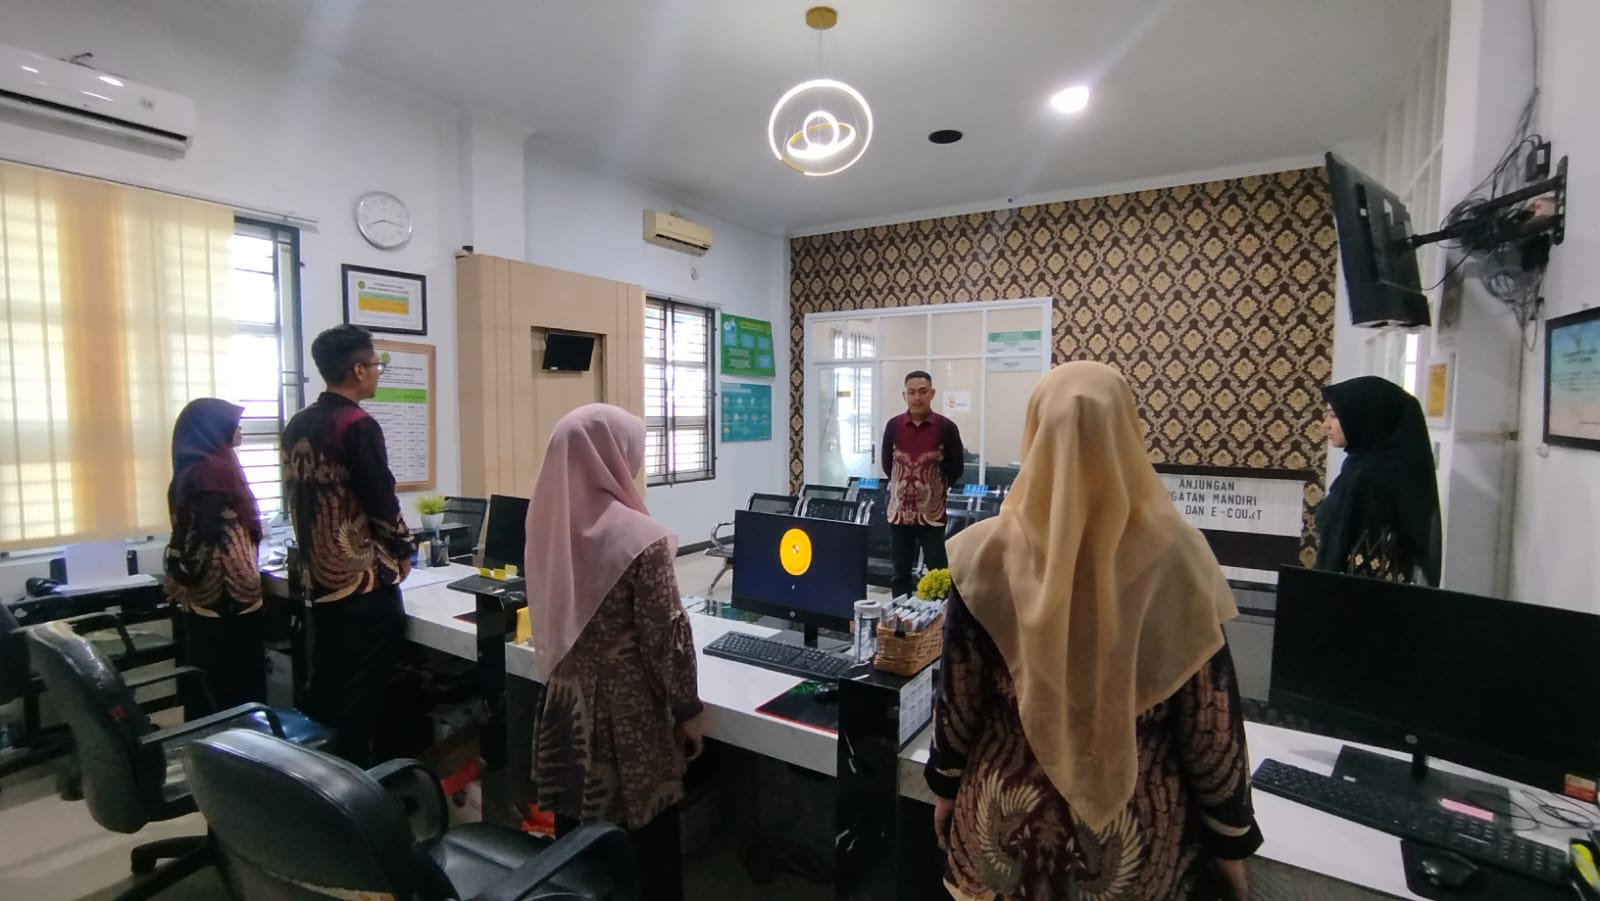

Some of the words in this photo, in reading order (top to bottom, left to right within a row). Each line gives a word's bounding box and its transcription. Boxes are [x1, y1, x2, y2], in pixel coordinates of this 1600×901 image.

[1179, 478, 1234, 491] ANJUNGAN
[1168, 491, 1205, 504] GATAN
[1213, 493, 1257, 506] MANDIRI
[1185, 505, 1204, 516] DAN
